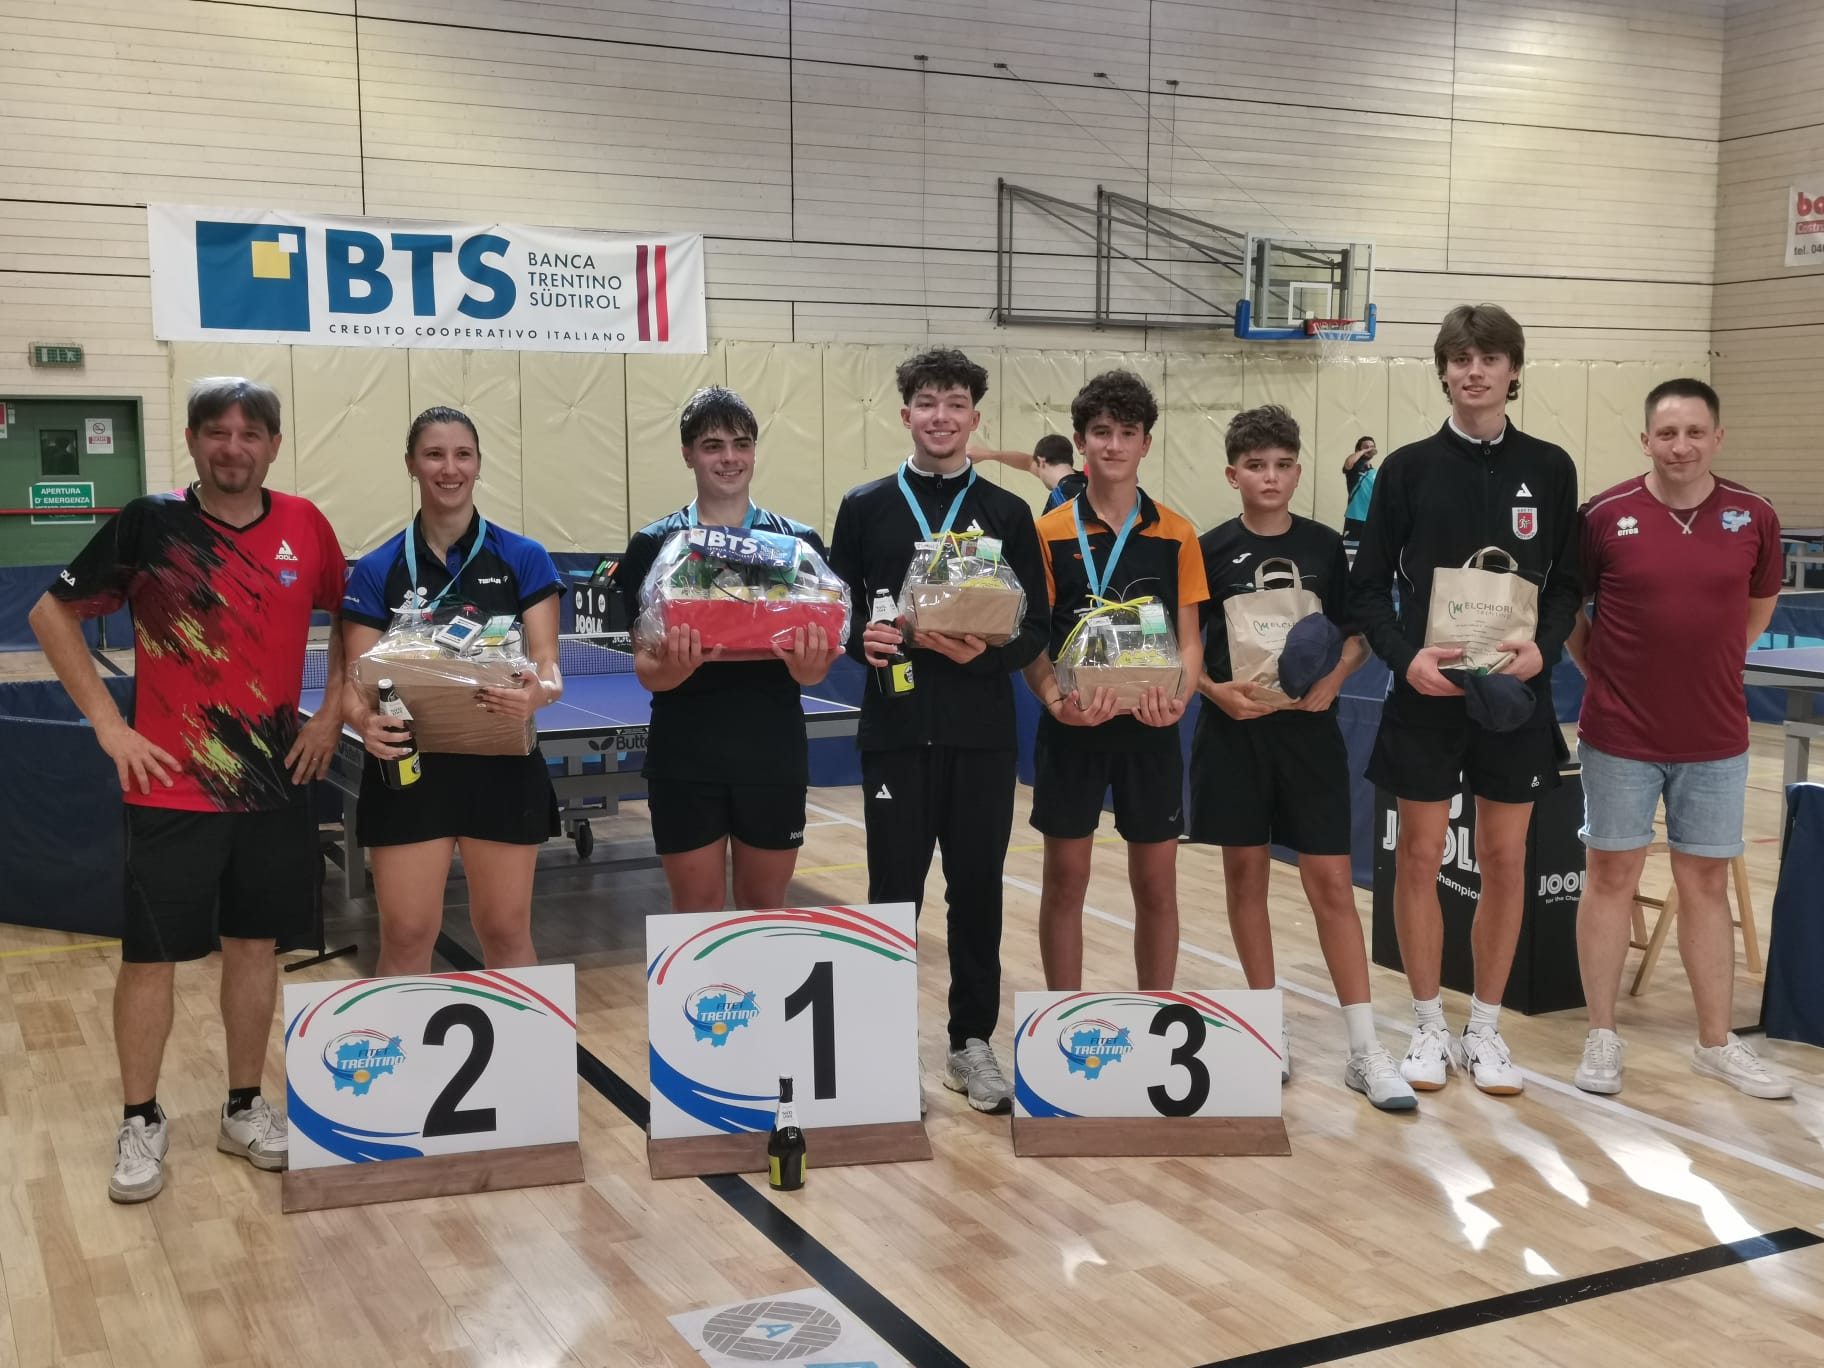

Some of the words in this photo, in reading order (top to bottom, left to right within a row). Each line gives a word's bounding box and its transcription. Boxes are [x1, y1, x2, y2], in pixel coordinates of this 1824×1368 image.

[528, 251, 595, 271] BANCA
[325, 228, 517, 320] BTS
[528, 271, 623, 291] TRENTINO
[529, 288, 621, 310] SÜDTIROL
[328, 323, 405, 337] CREDITO
[415, 326, 539, 340] COOPERATIVO
[546, 330, 627, 343] ITALIANO
[41, 487, 81, 495] APERTURA
[708, 530, 759, 555] BTS
[60, 569, 77, 588] OLA
[1448, 600, 1513, 620] MELCHIORI
[1435, 871, 1481, 901] hampio
[1538, 870, 1586, 897] JOOL
[700, 1009, 760, 1022] TRENTINO
[716, 1001, 744, 1011] FITET
[784, 961, 837, 1100] 1
[1090, 1036, 1119, 1045] FITET
[1074, 1045, 1134, 1056] TRENTINO
[1147, 1003, 1211, 1118] 3
[341, 1055, 406, 1070] TRENTINO
[422, 1003, 497, 1138] 2
